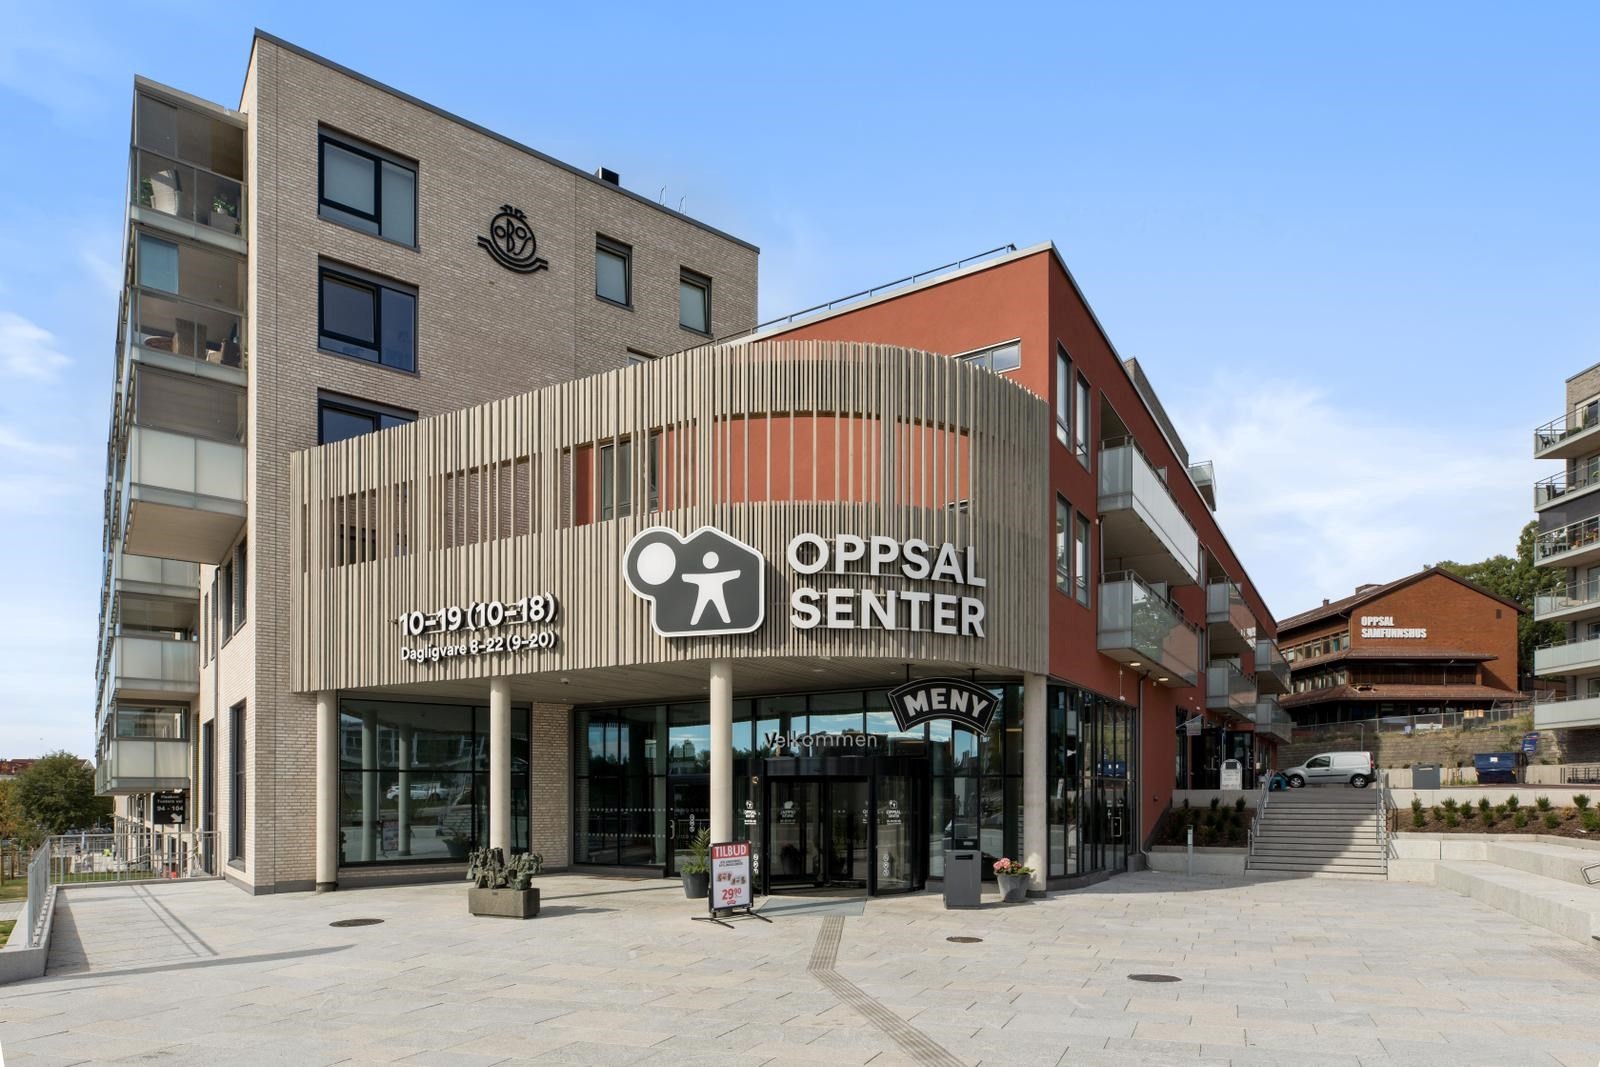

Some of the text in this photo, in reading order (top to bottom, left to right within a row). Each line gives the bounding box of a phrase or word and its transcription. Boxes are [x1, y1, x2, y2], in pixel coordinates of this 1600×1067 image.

[787, 533, 986, 587] OPPSAL
[400, 592, 555, 636] 10-19 (10-18)
[790, 587, 985, 638] SENTER
[1361, 616, 1394, 626] OPPSAL
[401, 630, 555, 663] Dagligvare 8-22 (9-20)
[1361, 628, 1427, 638] SAMFUNNSHUS
[903, 688, 989, 718] MENY
[764, 730, 878, 748] Velkommen
[715, 844, 747, 857] TILBUD
